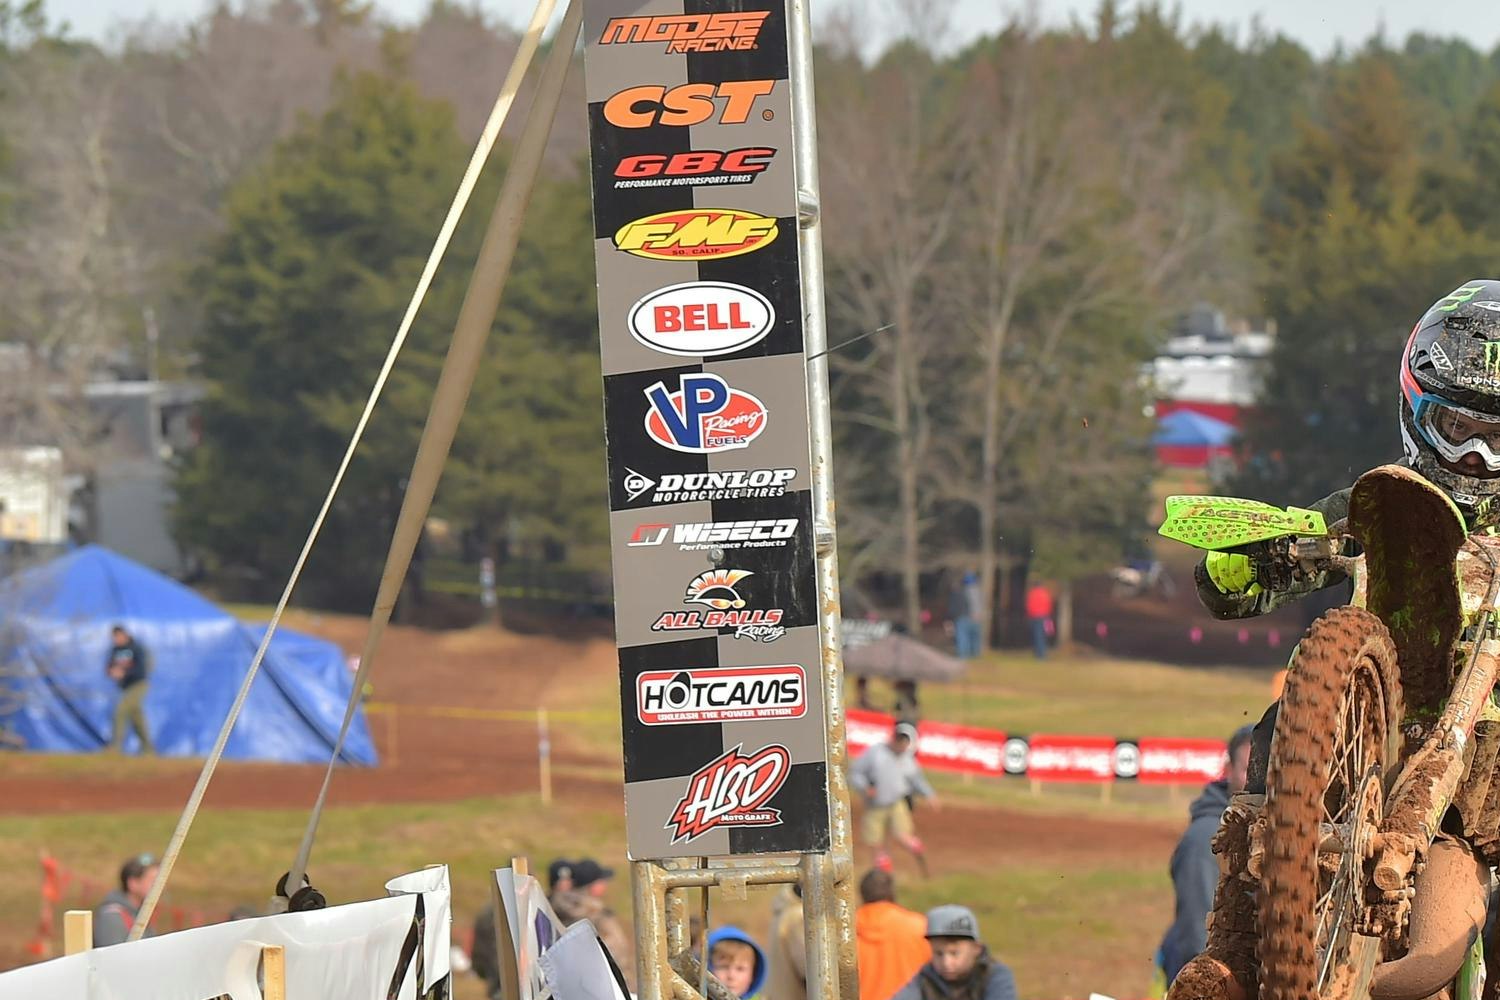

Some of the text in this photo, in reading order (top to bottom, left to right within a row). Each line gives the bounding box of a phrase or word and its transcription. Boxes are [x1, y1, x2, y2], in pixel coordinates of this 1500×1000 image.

[599, 11, 770, 44] MOOSE
[665, 37, 755, 54] RACING
[603, 80, 775, 128] CST
[614, 148, 777, 177] GBC
[614, 174, 752, 189] PERFORMANCE MOTORSPORTS TIRES
[616, 214, 777, 251] FMF
[654, 302, 751, 333] BELL
[648, 376, 729, 450] VP
[707, 435, 747, 446] FUELS
[656, 467, 797, 492] DUNLOP
[652, 486, 786, 503] MOTORCYCLE TIRES
[679, 540, 787, 551] Performance Products
[652, 609, 784, 631] ALL BALLS
[734, 624, 786, 642] Racing
[644, 675, 800, 710] HOTCAMS
[657, 708, 793, 721] UNLEASH THE POWER WITHIN
